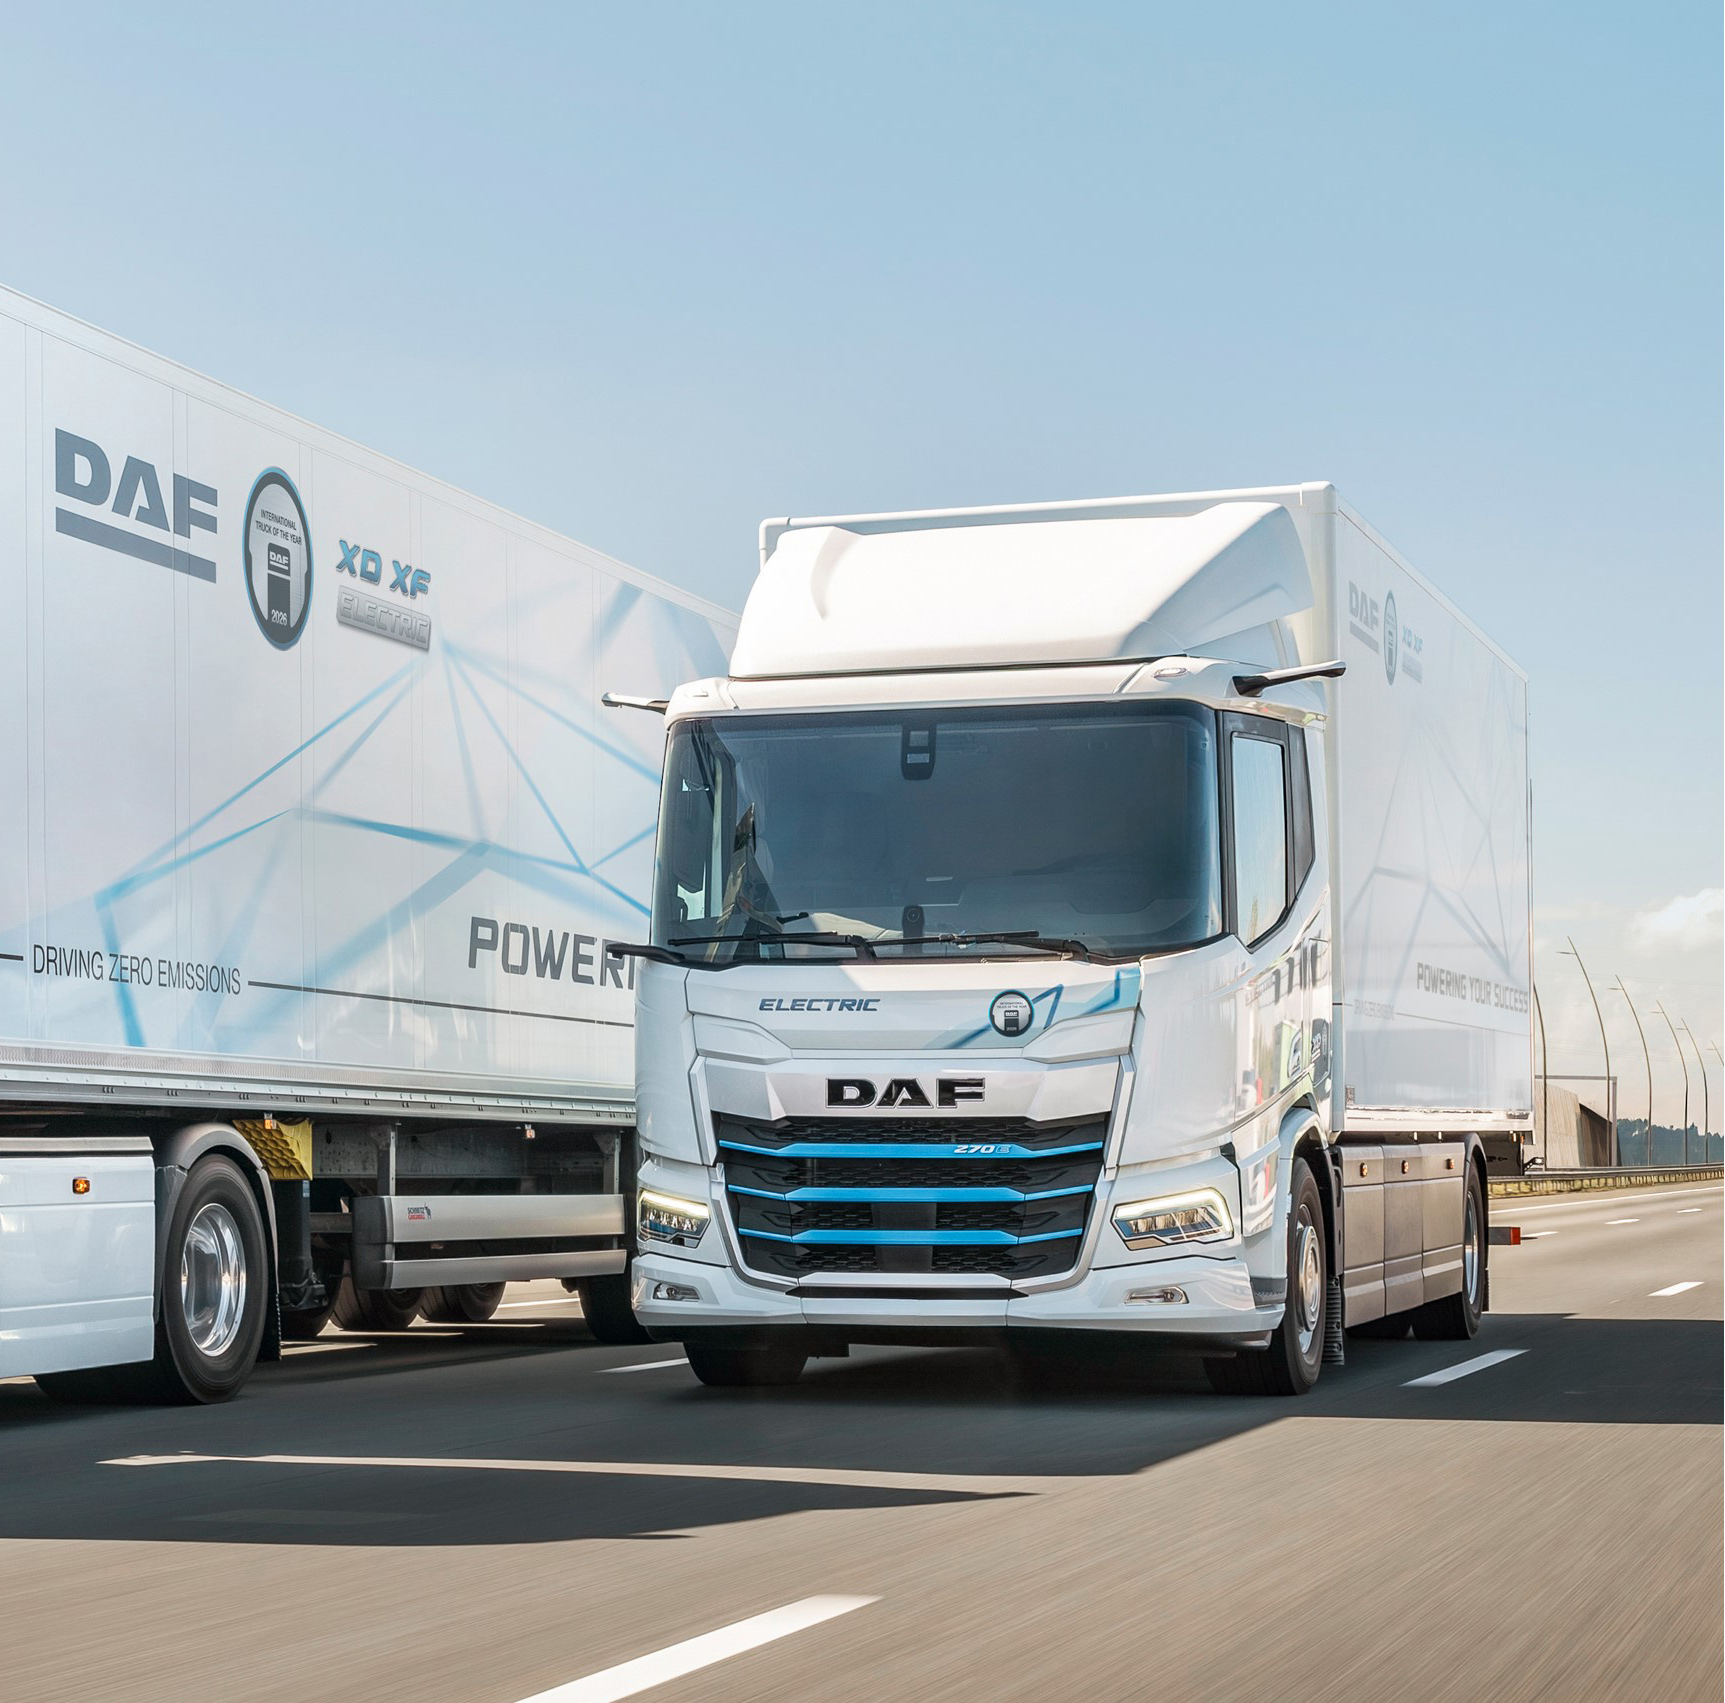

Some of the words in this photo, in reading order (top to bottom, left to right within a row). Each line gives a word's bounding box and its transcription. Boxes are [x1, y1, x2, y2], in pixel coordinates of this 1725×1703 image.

[55, 427, 218, 540] DAF
[255, 520, 273, 535] TRUCK
[272, 526, 280, 537] OF
[280, 529, 290, 541] THE
[290, 533, 302, 546] YEAR
[260, 508, 297, 531] INTERNATIONAL
[269, 550, 289, 565] DAF
[336, 539, 382, 586] XD
[389, 560, 431, 599] XF
[271, 609, 288, 626] 2026
[339, 591, 429, 645] ELECTRIC
[1348, 580, 1379, 632] DAF
[33, 944, 104, 981] DRIVING
[108, 953, 153, 986] ZERO
[158, 959, 241, 995] EMISSIONS
[1416, 962, 1467, 1001] POWERING
[1469, 976, 1492, 1006] YOUR
[1494, 983, 1529, 1014] SUCCESS
[759, 998, 881, 1012] ELECTRIC
[826, 1078, 985, 1109] DAF
